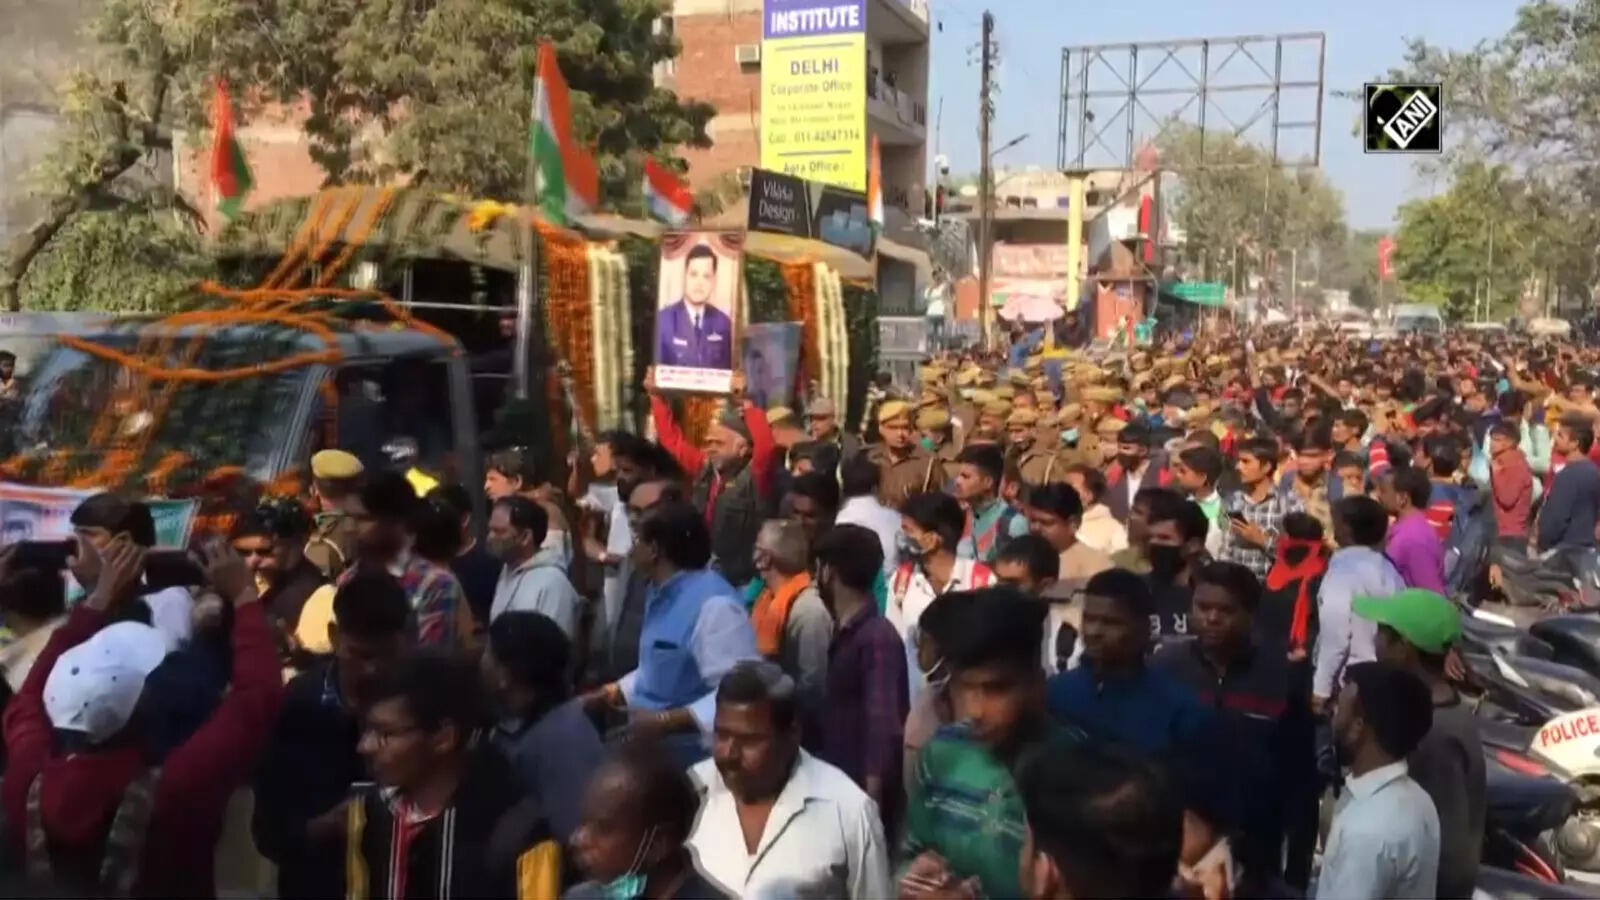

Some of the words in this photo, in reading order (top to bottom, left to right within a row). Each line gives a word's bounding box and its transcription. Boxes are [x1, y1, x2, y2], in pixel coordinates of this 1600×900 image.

[770, 4, 860, 34] INSTITUTE
[790, 58, 839, 76] DELHI
[770, 82, 818, 96] Corporate
[822, 79, 853, 93] Office
[758, 200, 796, 224] Design
[1541, 714, 1600, 748] POLICE
